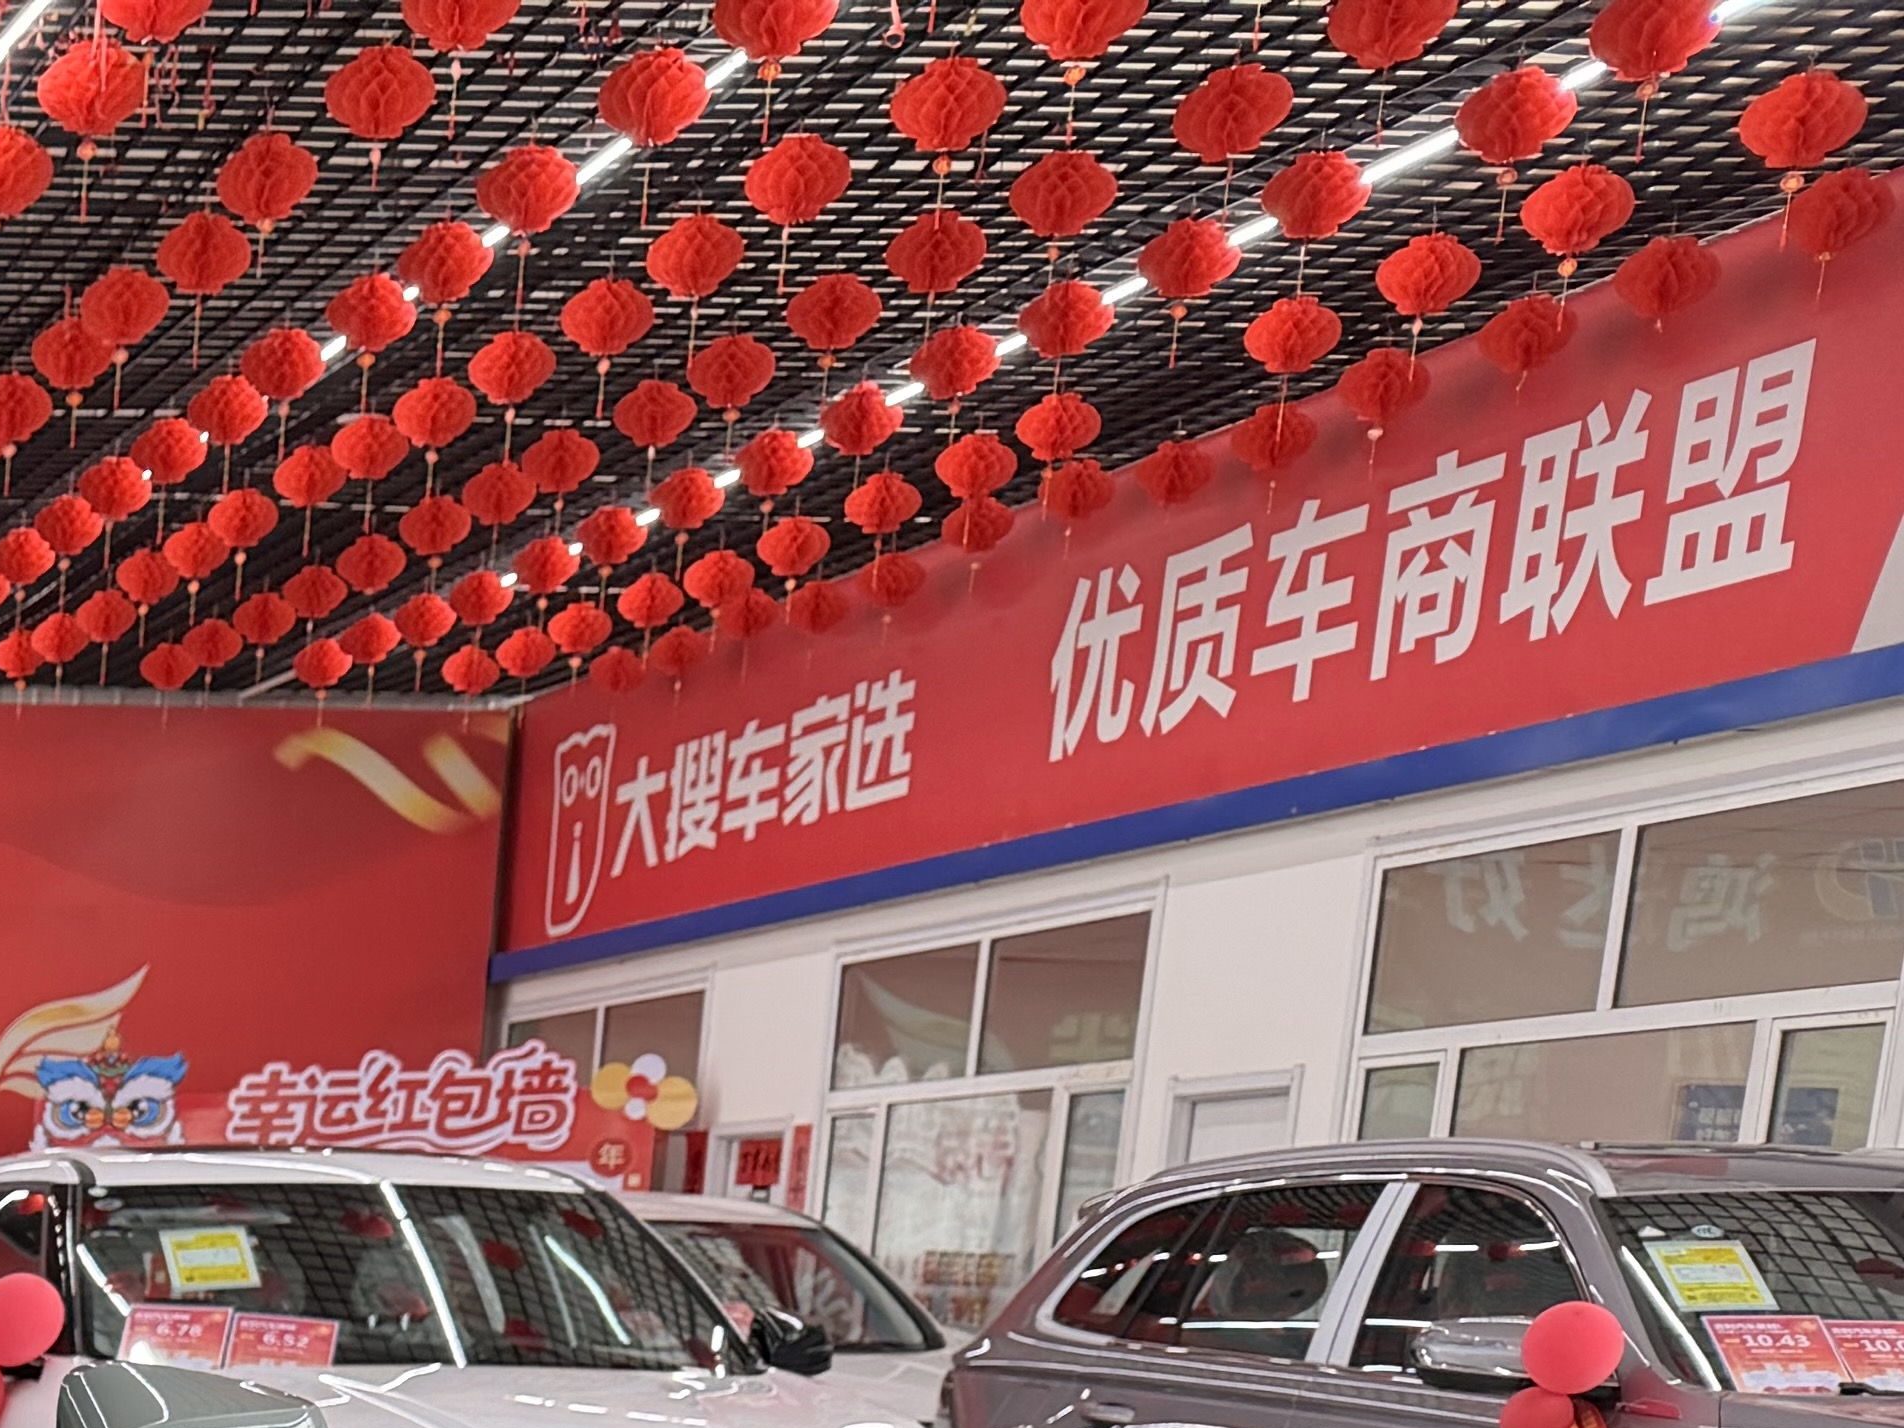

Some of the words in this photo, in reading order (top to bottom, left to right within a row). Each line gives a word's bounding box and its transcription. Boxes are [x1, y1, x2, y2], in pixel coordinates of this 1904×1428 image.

[1049, 338, 1819, 761] 优质车商联盟
[613, 669, 915, 879] 大搜车家选
[232, 1056, 574, 1146] 幸运红包墙
[597, 1141, 626, 1169] 年
[1742, 1334, 1811, 1348] 10.43
